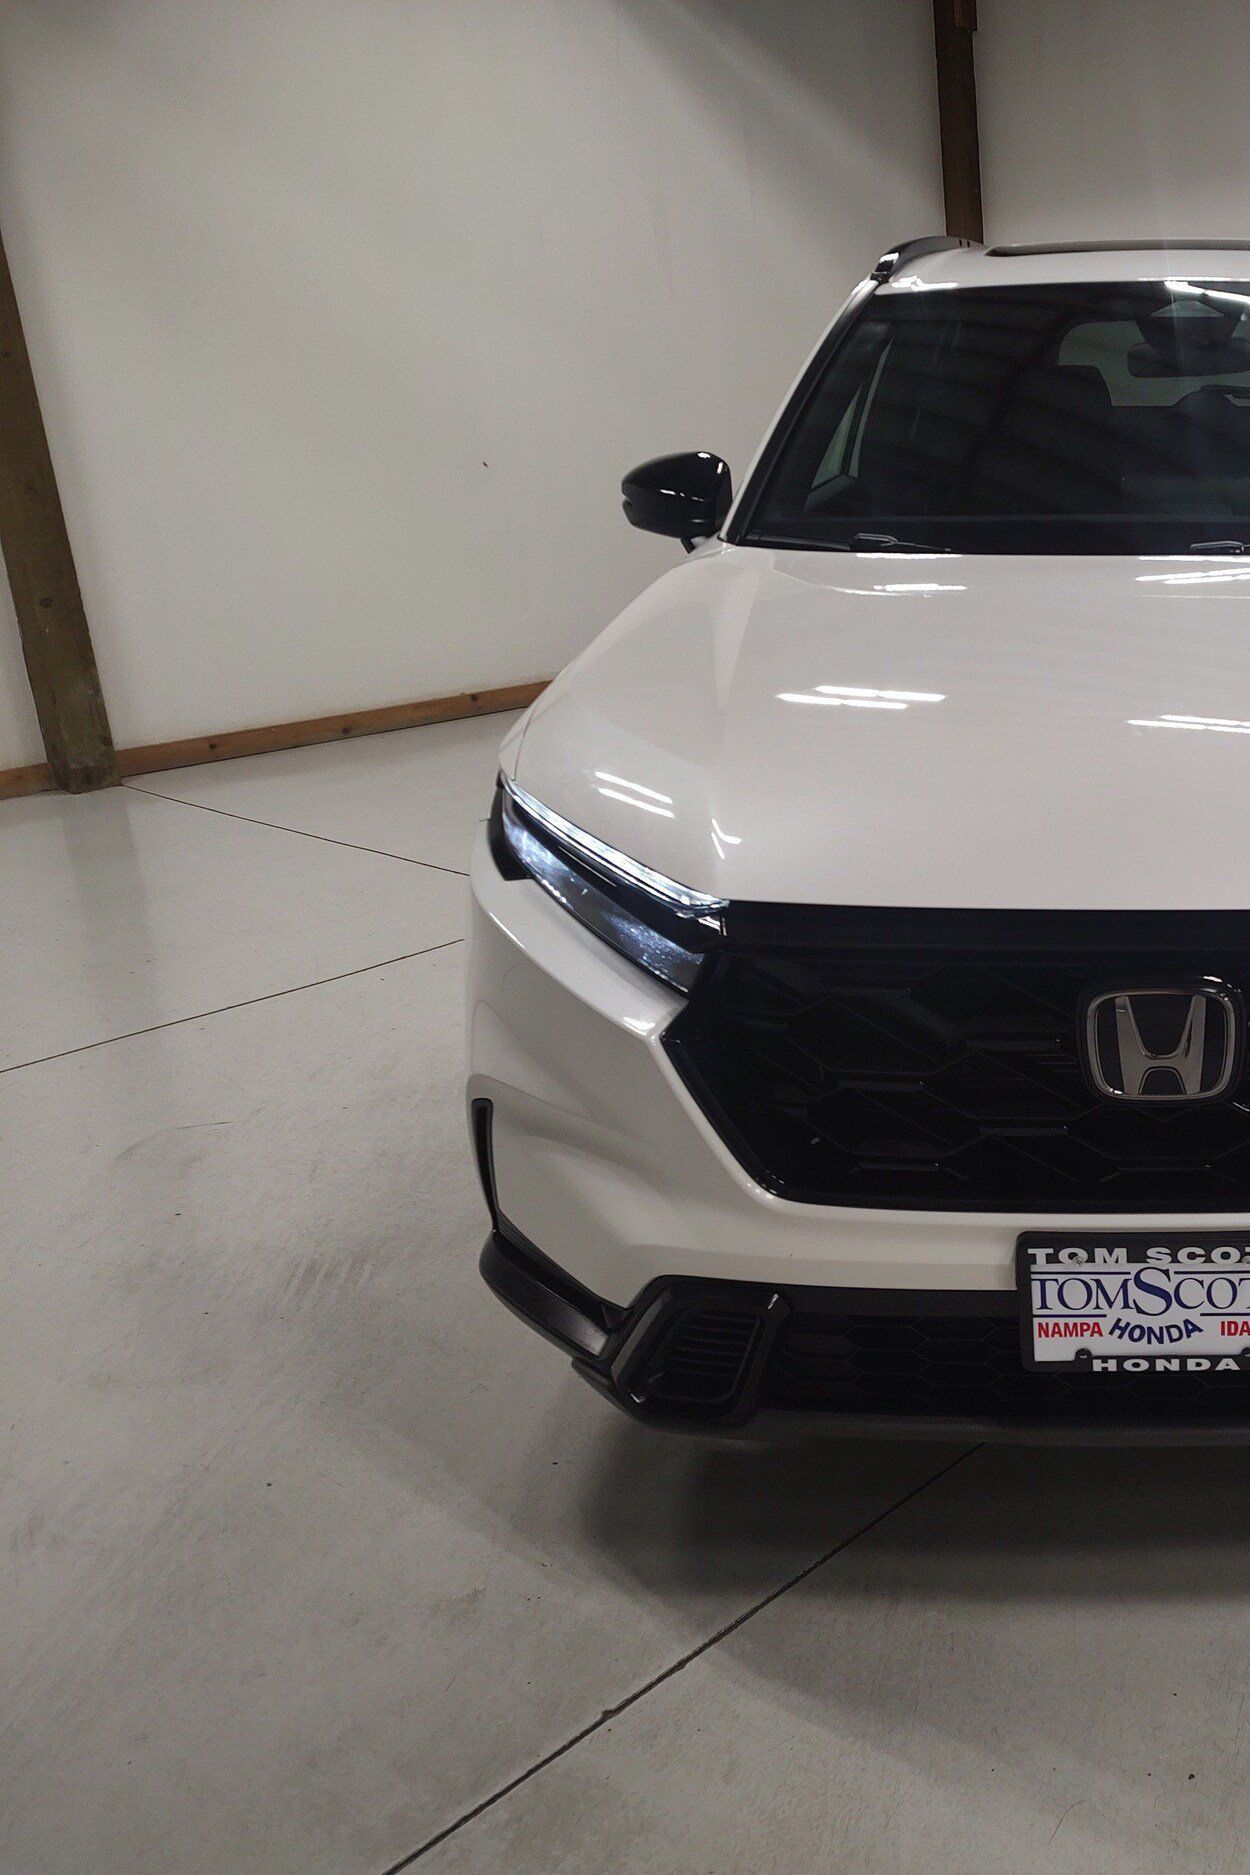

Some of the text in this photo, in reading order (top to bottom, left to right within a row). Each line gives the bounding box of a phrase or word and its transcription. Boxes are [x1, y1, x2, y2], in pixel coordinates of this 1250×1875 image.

[1027, 1247, 1128, 1265] TOM
[1037, 1322, 1103, 1338] NAMPA
[1108, 1318, 1204, 1345] HONDA
[1093, 1358, 1240, 1372] HONDA
